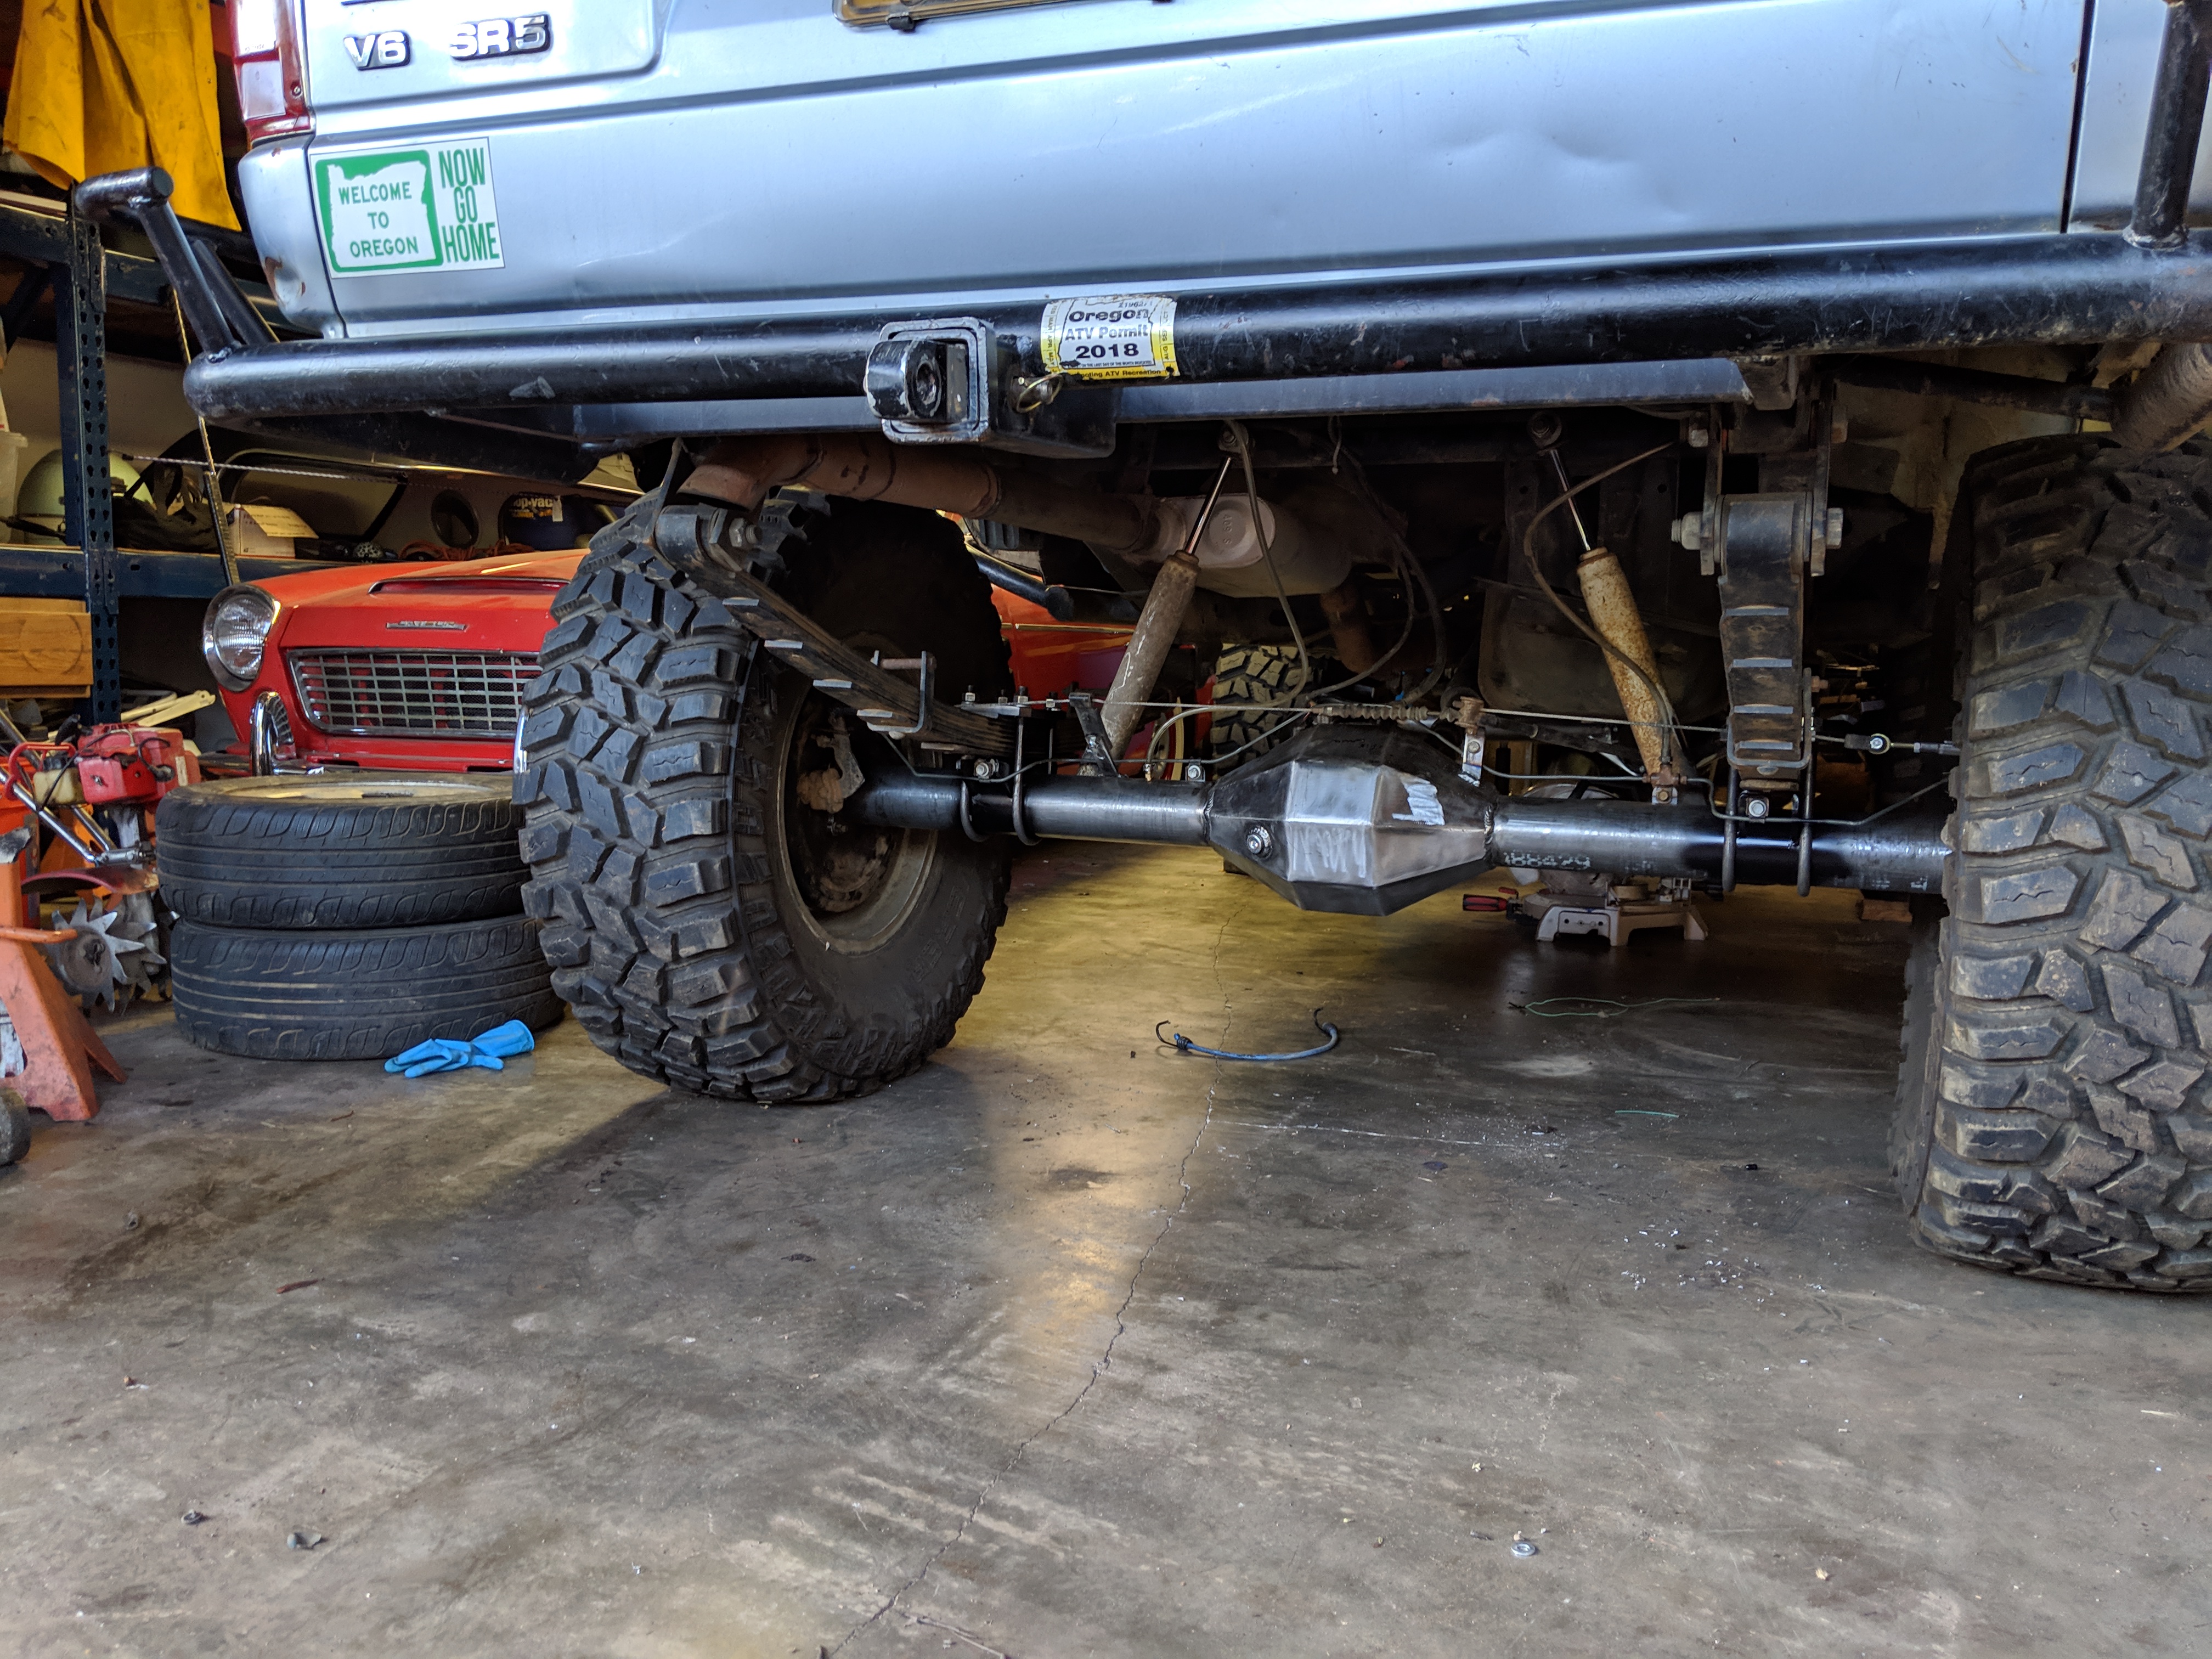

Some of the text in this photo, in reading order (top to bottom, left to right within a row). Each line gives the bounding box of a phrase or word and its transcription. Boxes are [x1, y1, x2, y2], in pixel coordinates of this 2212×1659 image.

[344, 15, 549, 69] V6 SR5
[438, 148, 486, 188] NOW
[338, 182, 412, 205] WELCOME
[453, 185, 478, 223] GO
[368, 211, 390, 230] TO
[350, 236, 419, 257] OREGON
[442, 222, 499, 263] HOME
[1069, 308, 1149, 323] Oregon
[1065, 324, 1148, 341] ATV Permit
[1075, 343, 1139, 359] 2018
